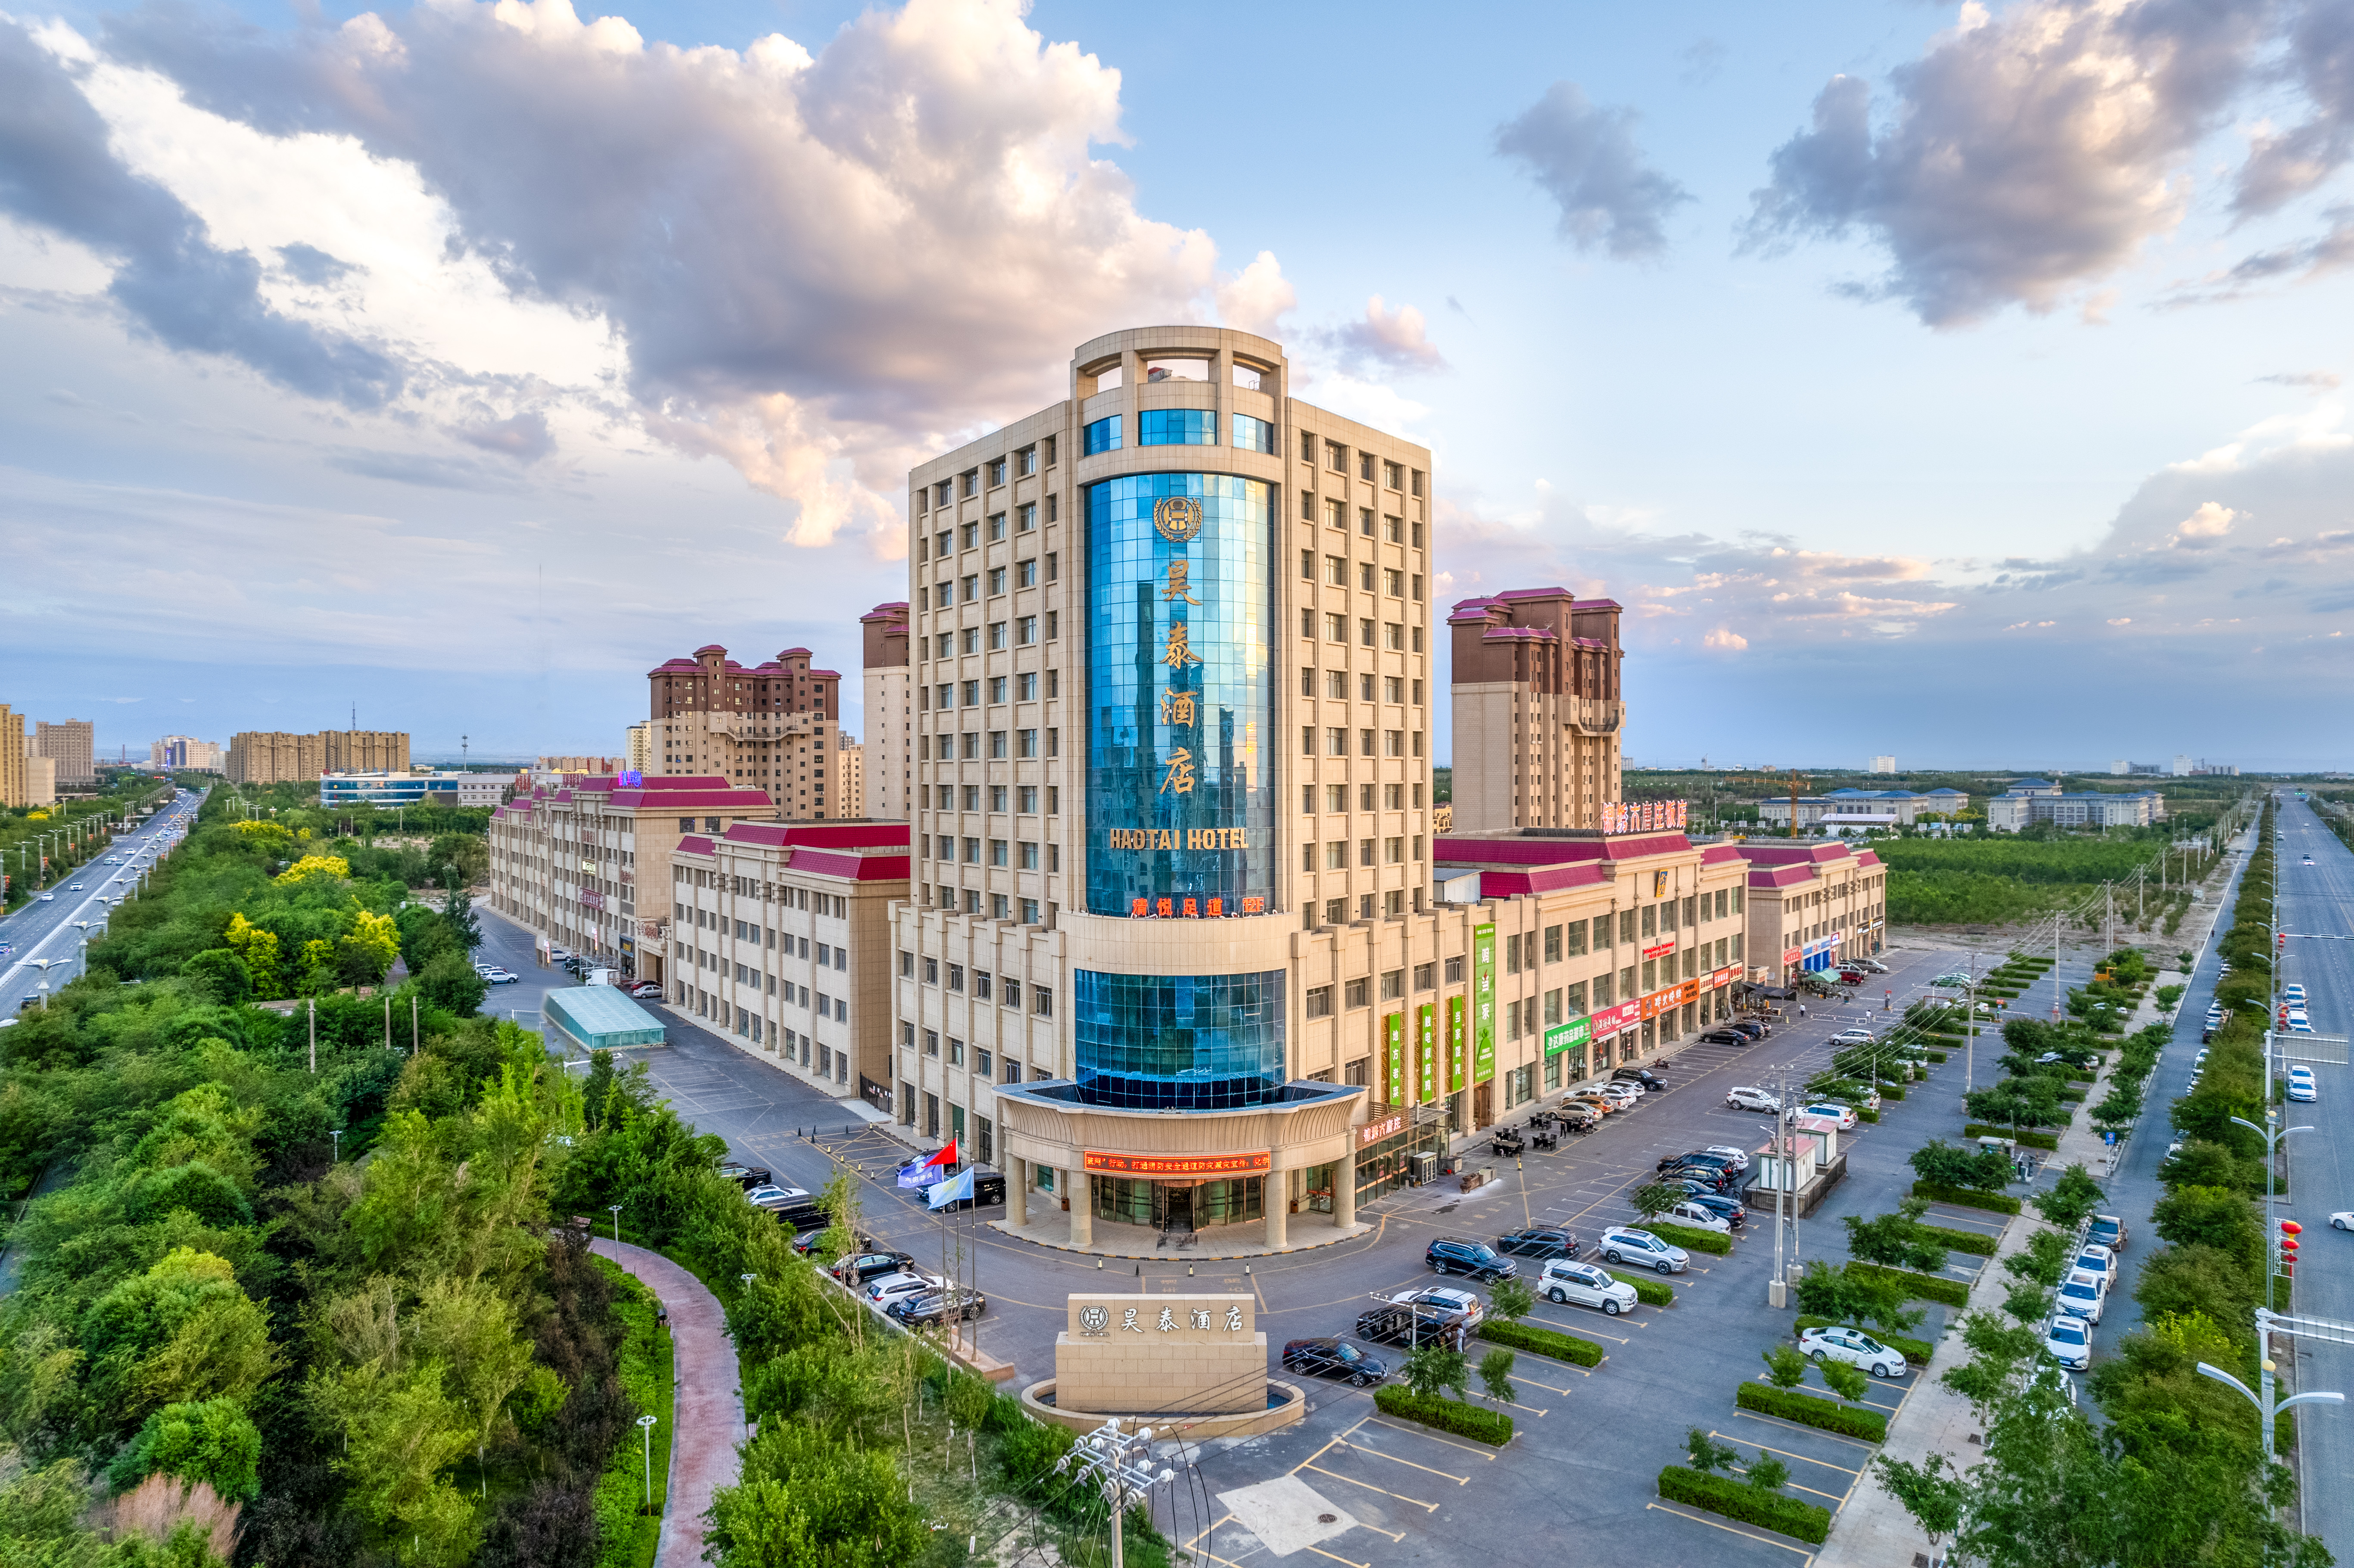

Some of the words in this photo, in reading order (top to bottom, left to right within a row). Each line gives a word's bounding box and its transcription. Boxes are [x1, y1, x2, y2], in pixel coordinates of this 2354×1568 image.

[1160, 560, 1204, 794] 昊泰酒店
[1602, 799, 1688, 835] 锦绣大唐庄饭店
[1110, 828, 1180, 850] HAOTAI
[1187, 828, 1249, 849] HOTEL
[1132, 897, 1223, 916] 清悦足道
[1243, 897, 1264, 912] 12F
[1121, 1305, 1244, 1334] 昊泰酒店
